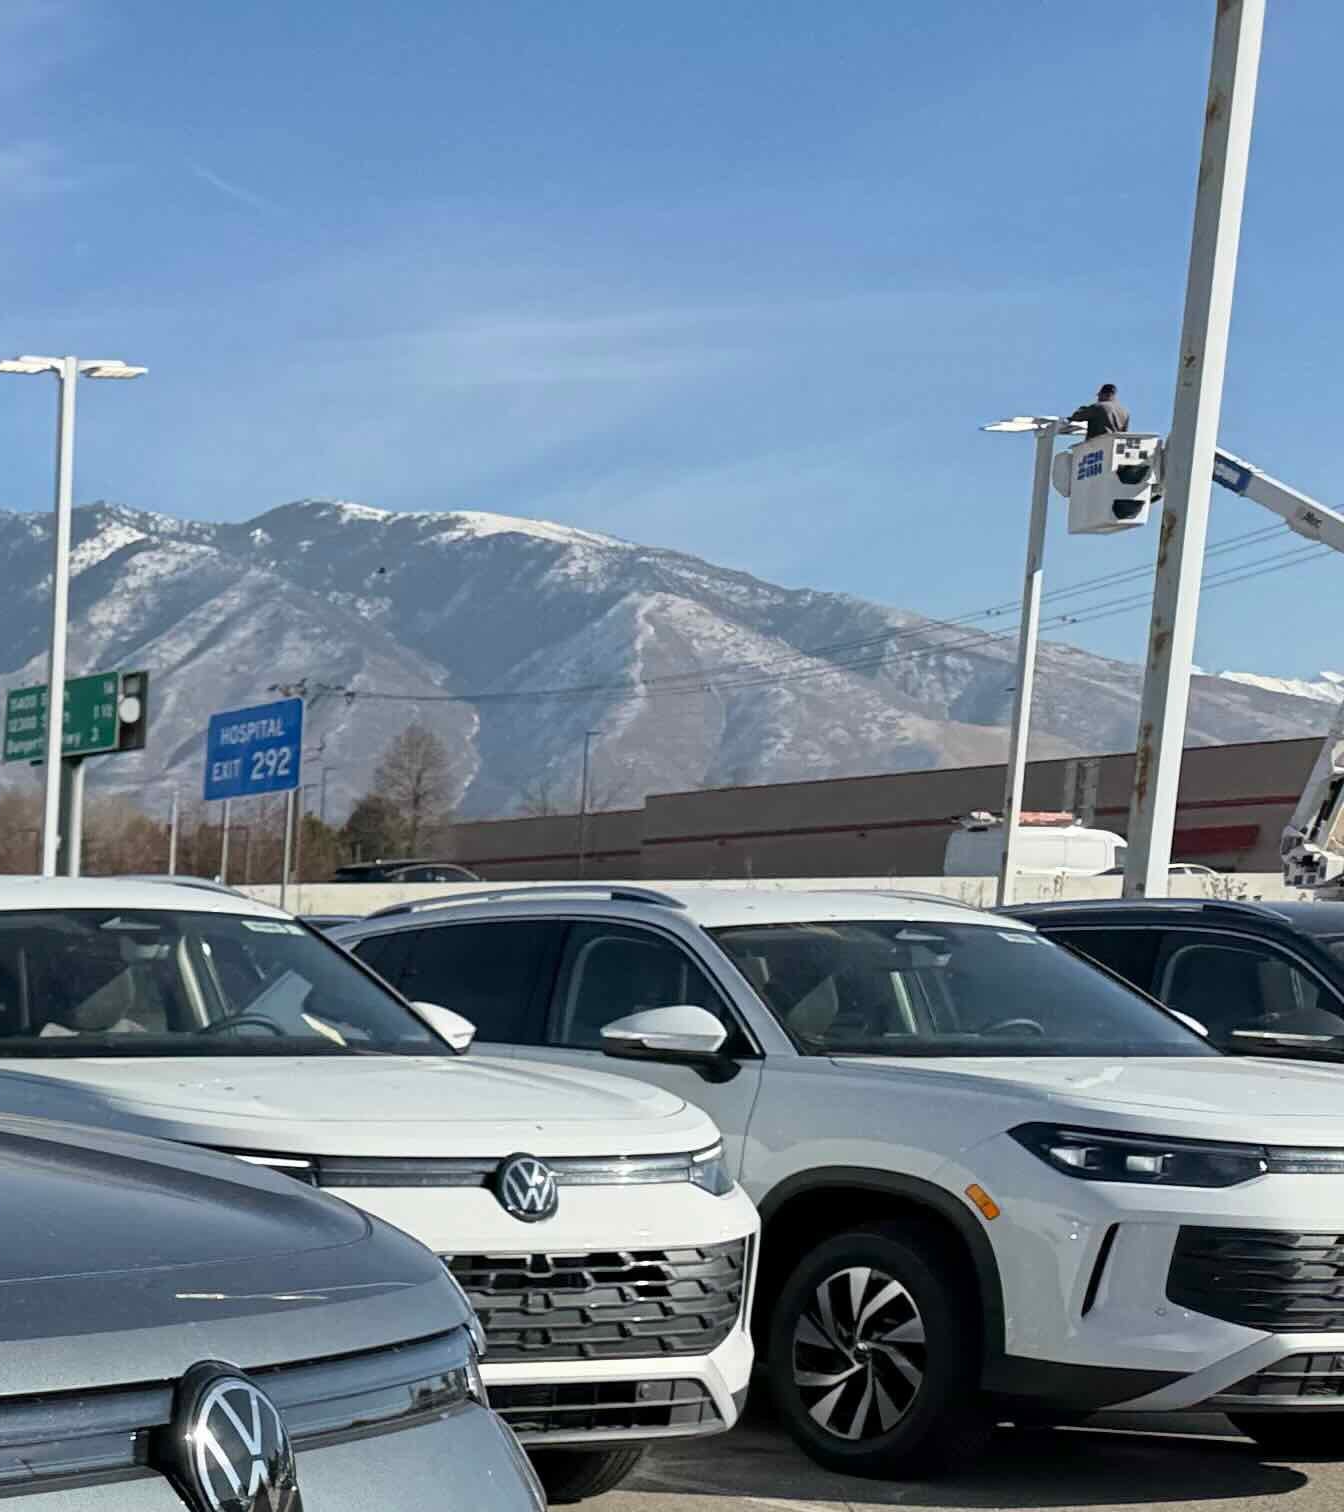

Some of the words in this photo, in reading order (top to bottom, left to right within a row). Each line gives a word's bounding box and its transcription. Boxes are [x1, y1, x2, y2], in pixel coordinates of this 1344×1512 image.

[219, 717, 286, 745] HOSPITAL
[212, 759, 241, 782] EXIT
[250, 746, 291, 781] 292
